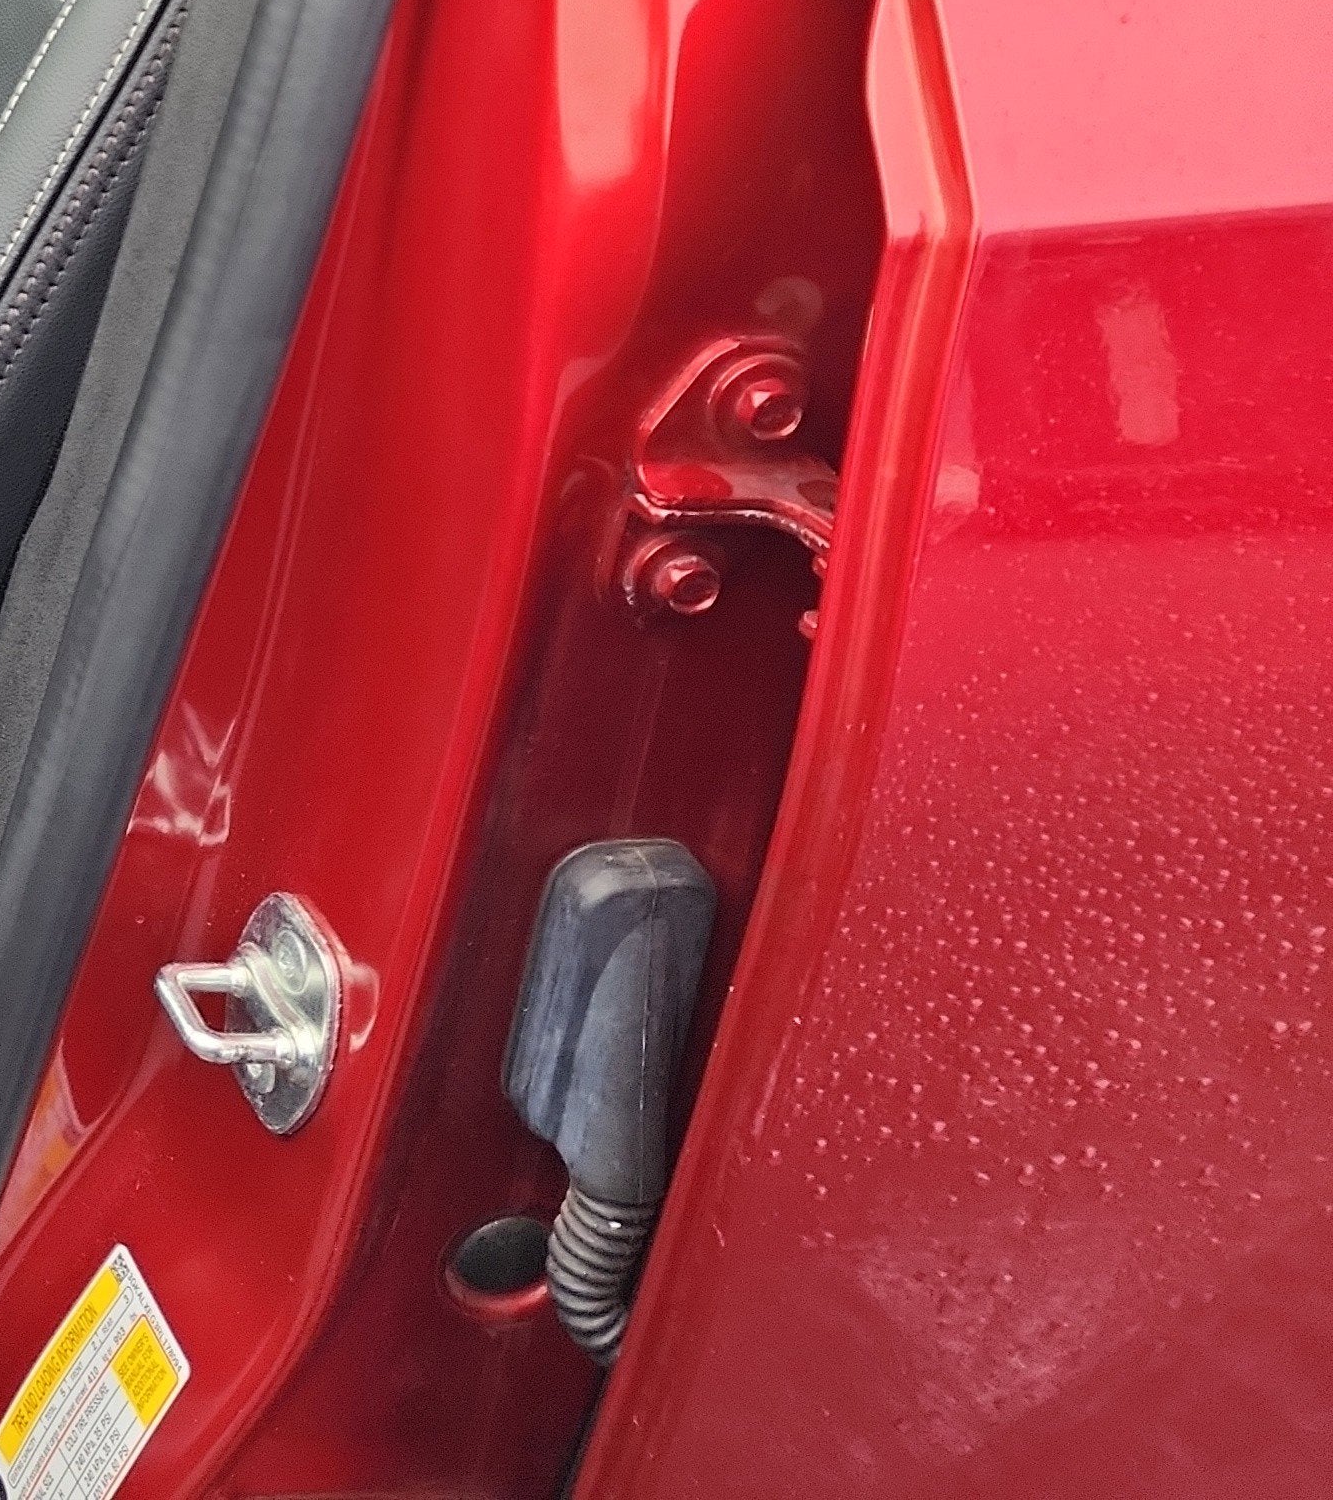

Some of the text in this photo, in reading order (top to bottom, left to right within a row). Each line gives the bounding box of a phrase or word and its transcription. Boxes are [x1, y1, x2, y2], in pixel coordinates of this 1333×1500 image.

[11, 1304, 98, 1436] TIRE AND LOADING INFORMATION
[87, 1366, 99, 1384] 410
